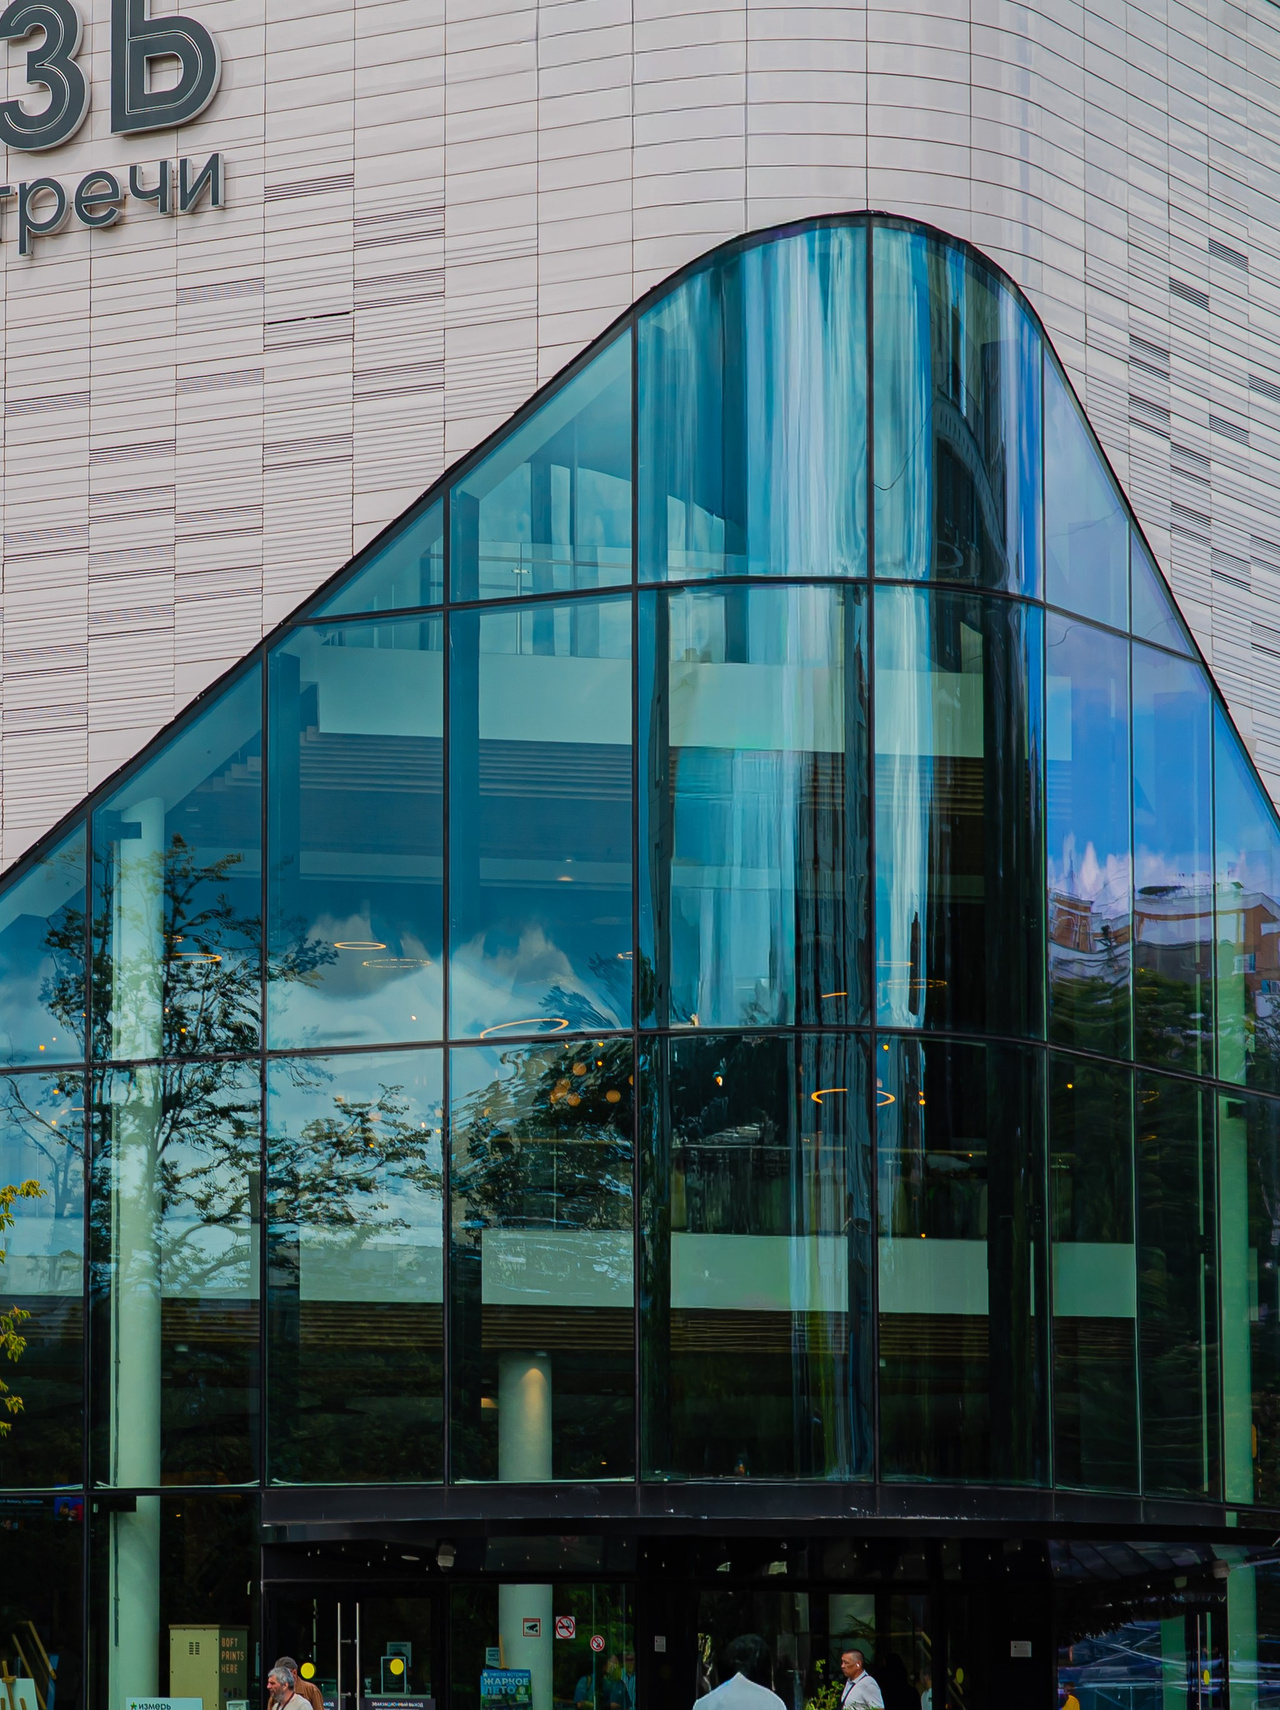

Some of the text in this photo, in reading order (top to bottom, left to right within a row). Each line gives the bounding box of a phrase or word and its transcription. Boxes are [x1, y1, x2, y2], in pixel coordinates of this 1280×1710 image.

[221, 1637, 238, 1648] BOFT
[221, 1650, 244, 1661] PRINTS
[221, 1663, 238, 1674] HERE
[484, 1678, 529, 1686] ЖАРКОЕ
